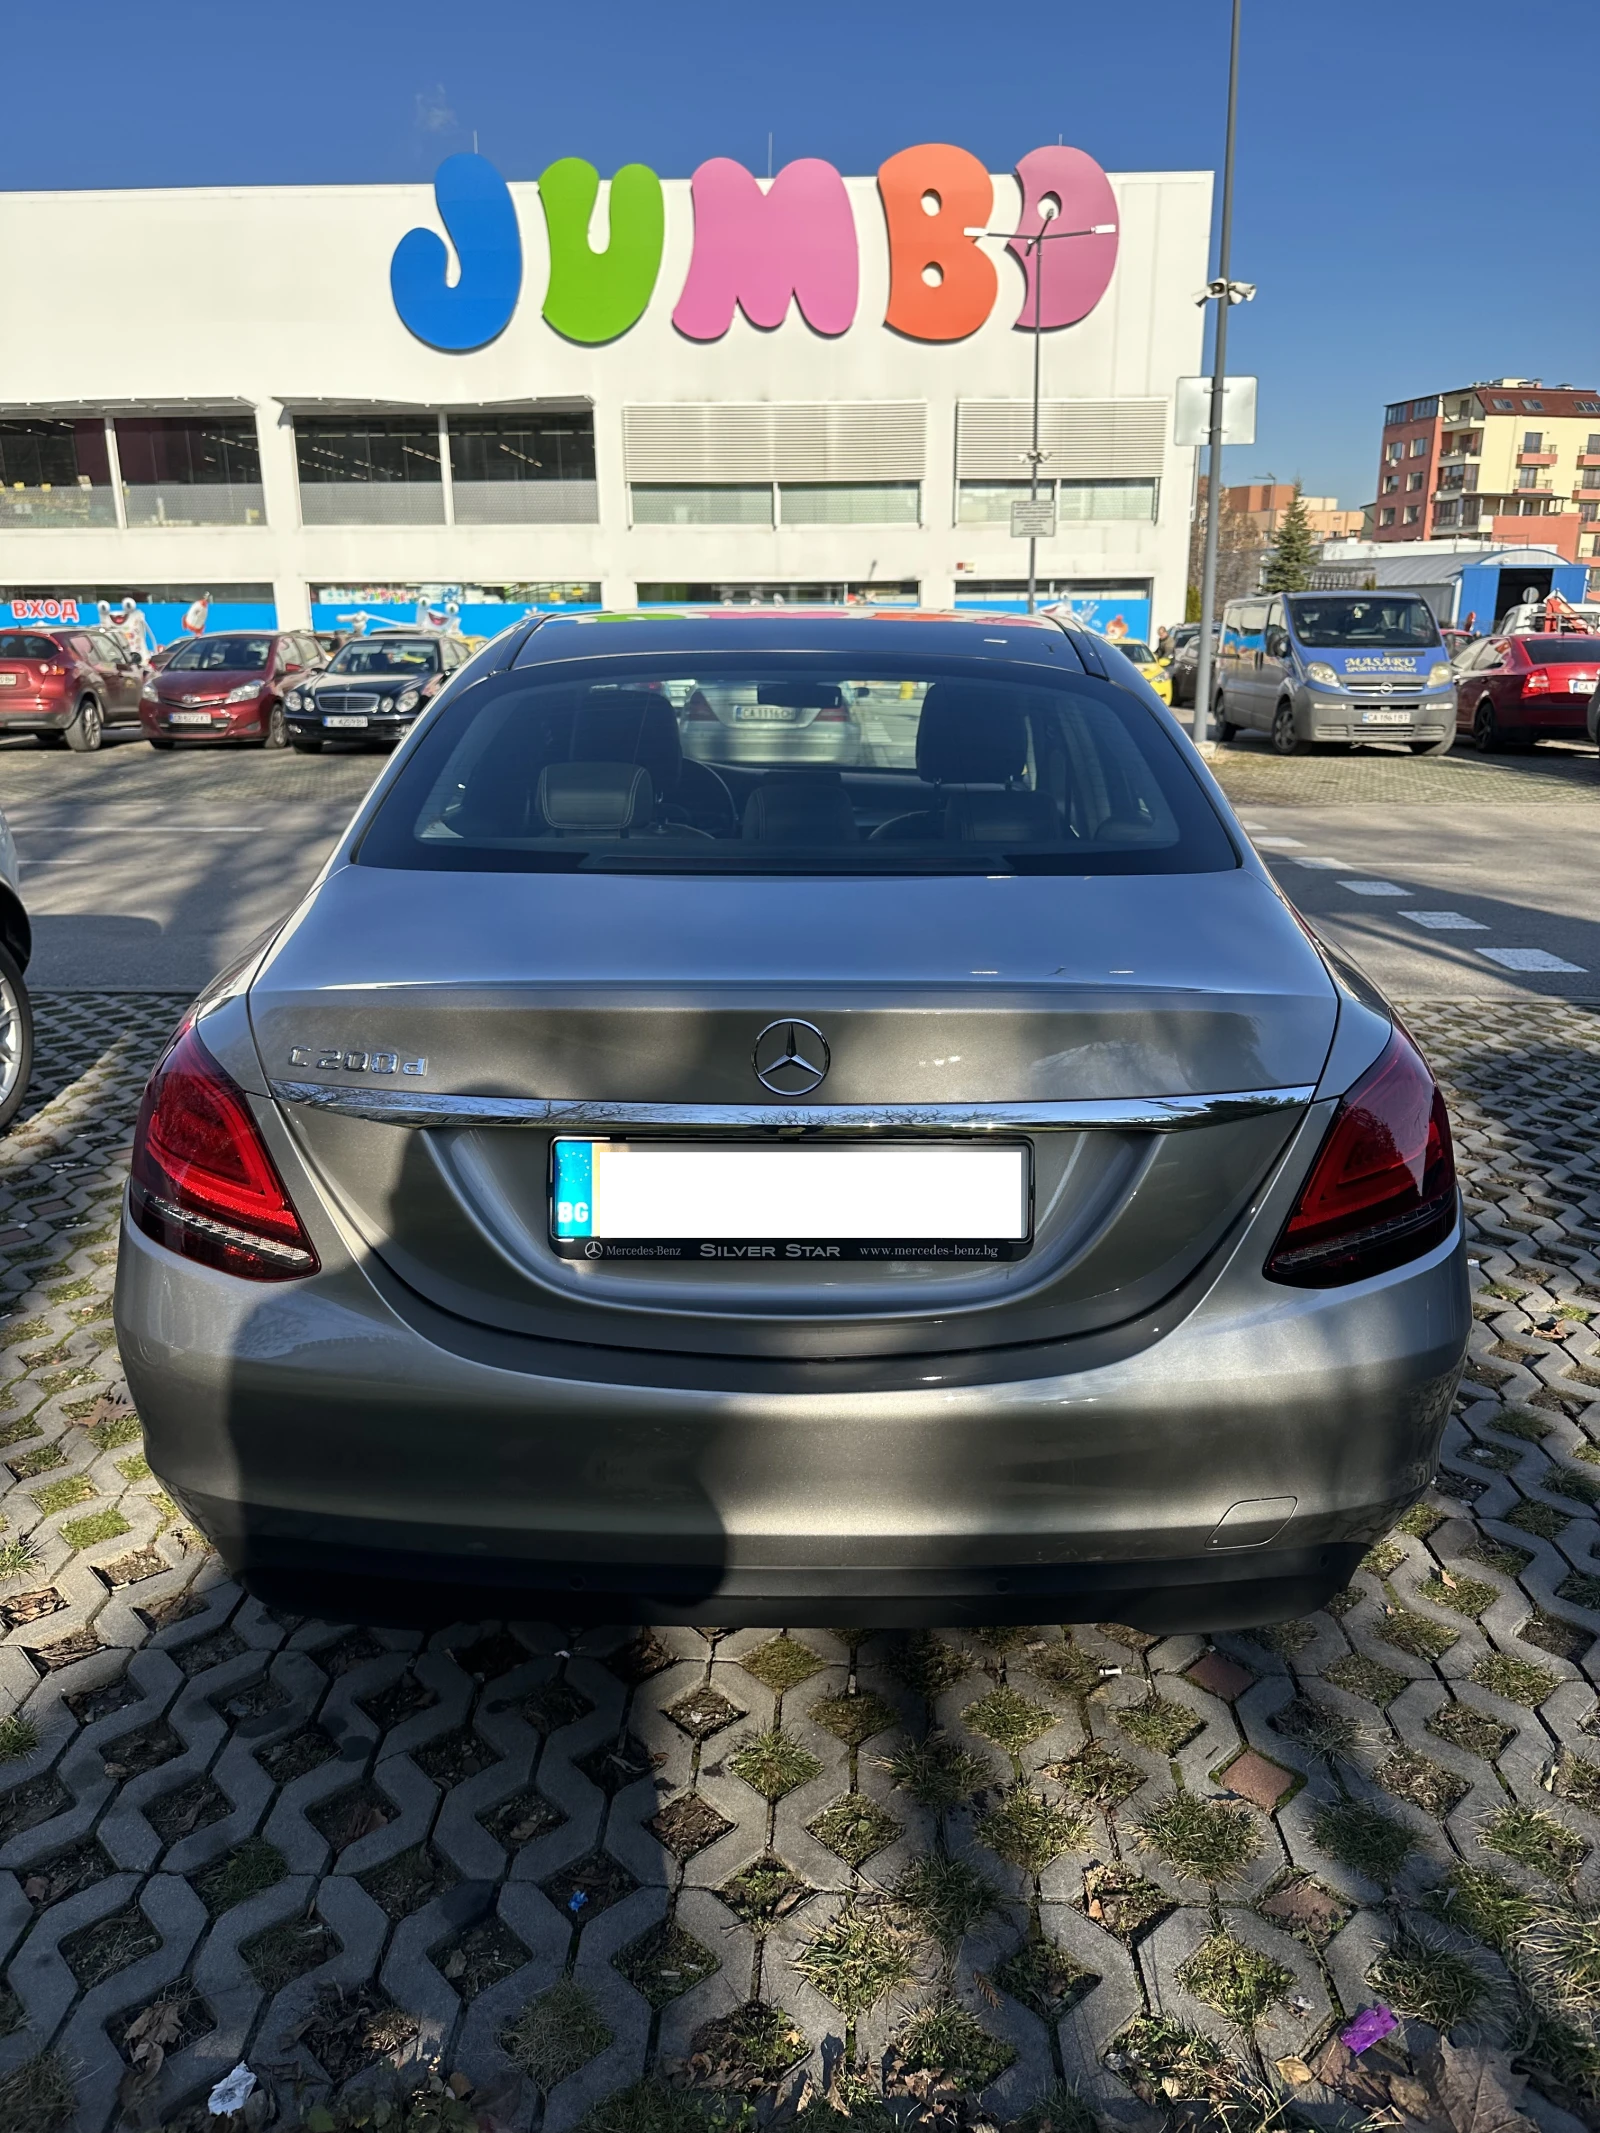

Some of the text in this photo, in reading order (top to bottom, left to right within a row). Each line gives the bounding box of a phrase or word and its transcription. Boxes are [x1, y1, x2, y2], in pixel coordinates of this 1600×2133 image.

[390, 143, 1119, 354] JUMBO
[11, 599, 80, 623] ВХОД
[1345, 657, 1416, 667] MASARU
[288, 1045, 428, 1077] C 200 d
[558, 1202, 589, 1223] BG
[606, 1243, 999, 1258] Mercedes-Benz SILVER STAR www.mercedes-benz.bg
